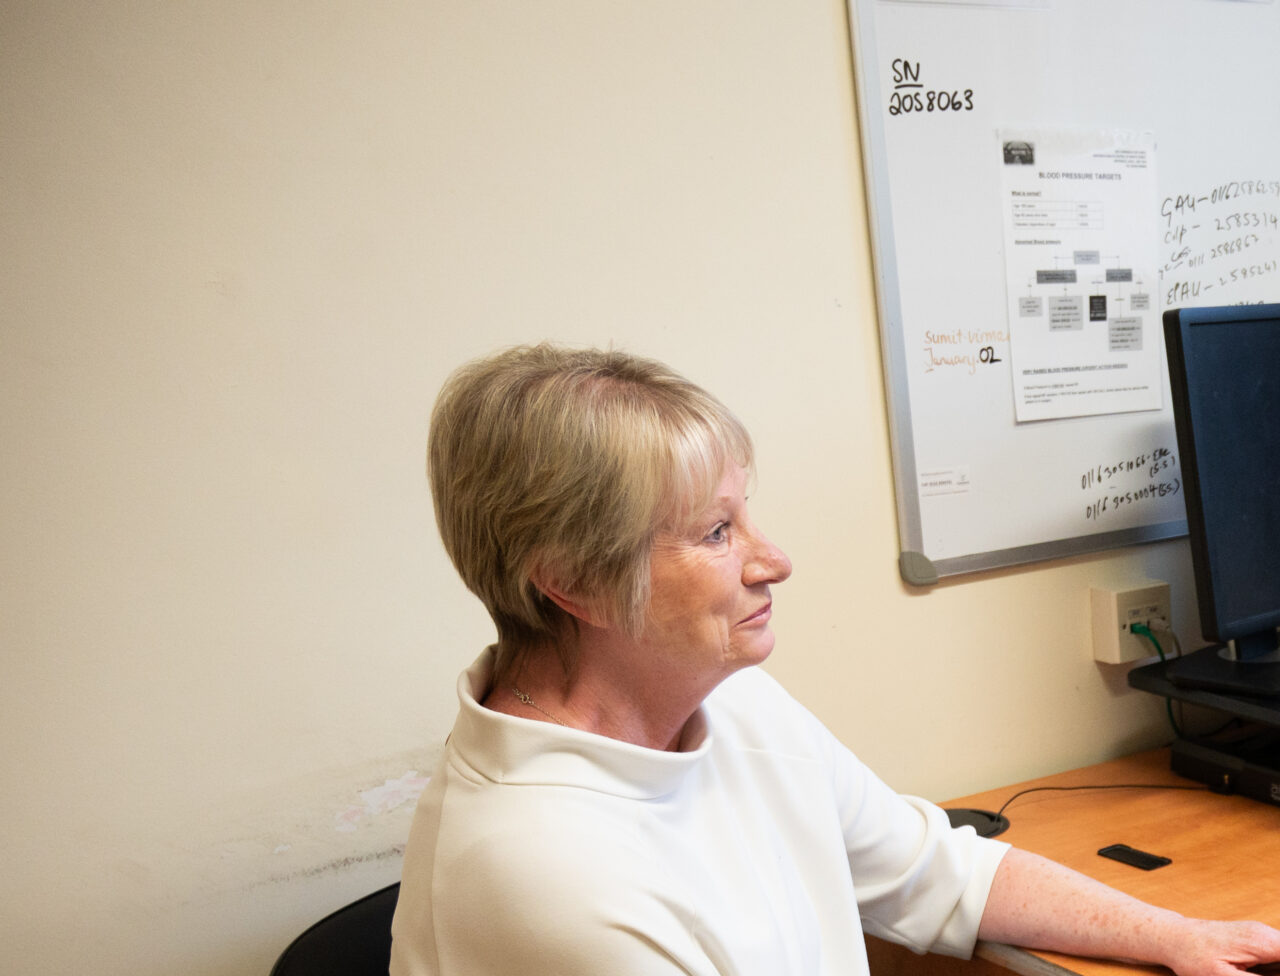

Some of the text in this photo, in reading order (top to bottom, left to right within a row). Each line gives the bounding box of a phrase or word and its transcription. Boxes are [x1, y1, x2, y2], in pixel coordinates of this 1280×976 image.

[892, 58, 921, 84] SN
[1038, 171, 1122, 181] BLOOD PRESSURE TARGETS
[979, 346, 1003, 364] 02
